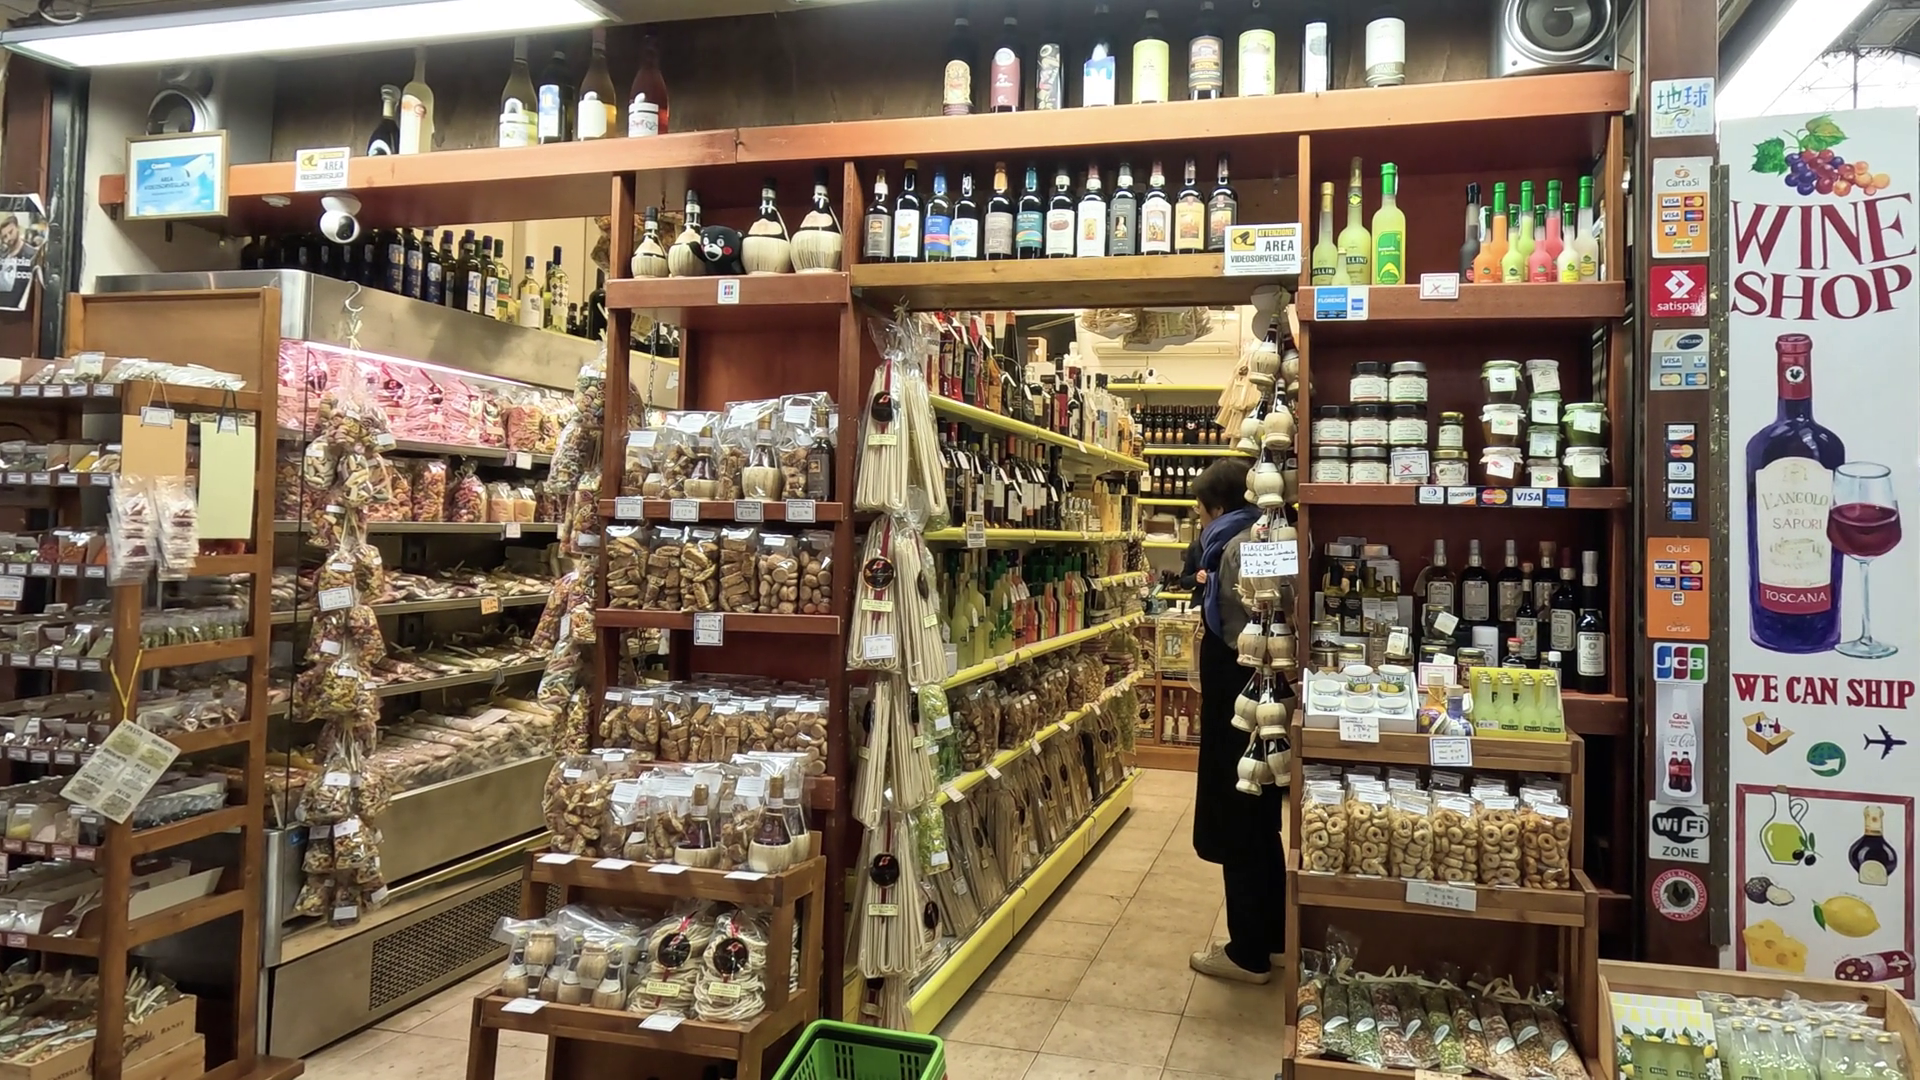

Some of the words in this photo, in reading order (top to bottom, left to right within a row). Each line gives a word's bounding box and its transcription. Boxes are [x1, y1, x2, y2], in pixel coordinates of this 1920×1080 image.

[324, 161, 343, 170] AREA
[1666, 178, 1700, 187] CartaSi
[1730, 193, 1917, 270] WINE
[1265, 240, 1294, 252] AREA
[1231, 254, 1295, 263] VIDEOSORVEGLIATA
[1730, 264, 1912, 320] SHOP
[1657, 302, 1701, 313] satispay
[1516, 492, 1541, 501] VISA
[1762, 492, 1828, 511] L'ANGOLO
[1772, 518, 1823, 529] SAPORI
[1666, 545, 1681, 553] Qui
[1765, 589, 1827, 602] TOSCANA
[1657, 656, 1704, 670] JCB
[1732, 673, 1778, 702] WE
[1786, 676, 1838, 705] CAN
[1846, 679, 1915, 709] SHIP
[1662, 846, 1699, 858] ZONE
[160, 1020, 185, 1035] BANFI
